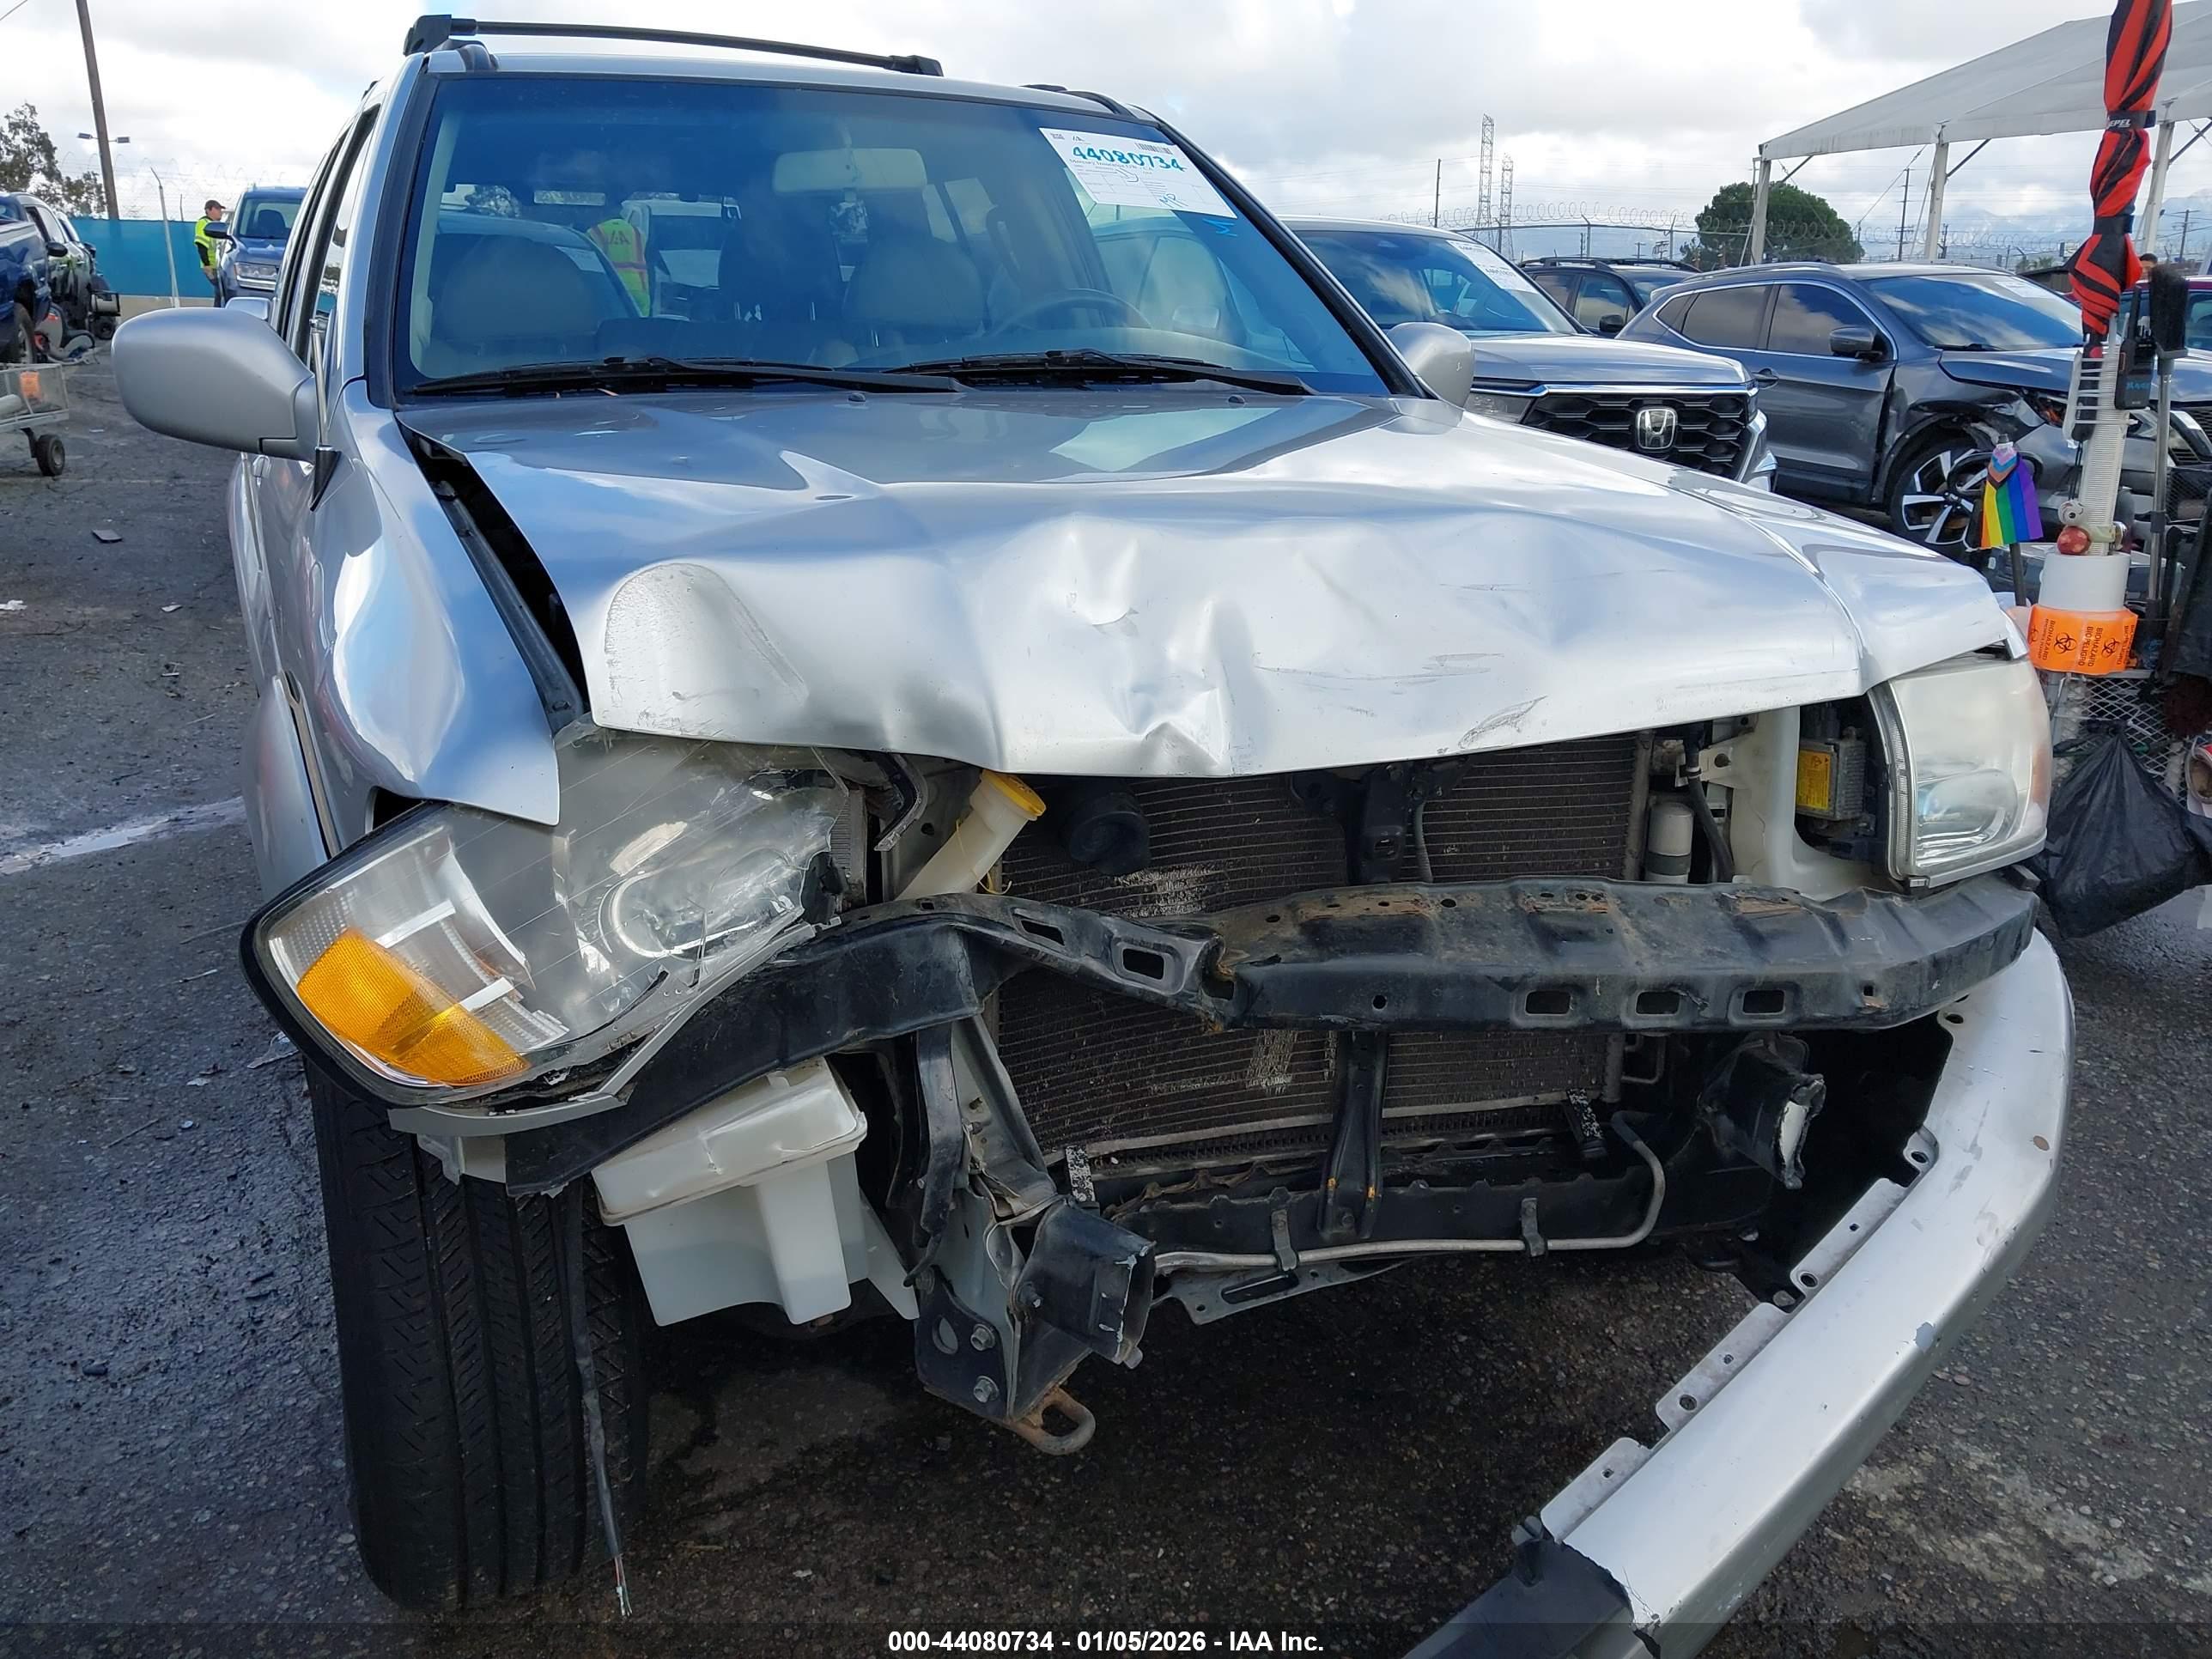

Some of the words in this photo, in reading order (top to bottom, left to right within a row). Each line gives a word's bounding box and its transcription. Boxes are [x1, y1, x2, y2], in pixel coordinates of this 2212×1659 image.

[1073, 146, 1188, 172] 44080734
[2043, 620, 2056, 660] BIOHAZARD
[2087, 627, 2103, 667] BIOHAZARD
